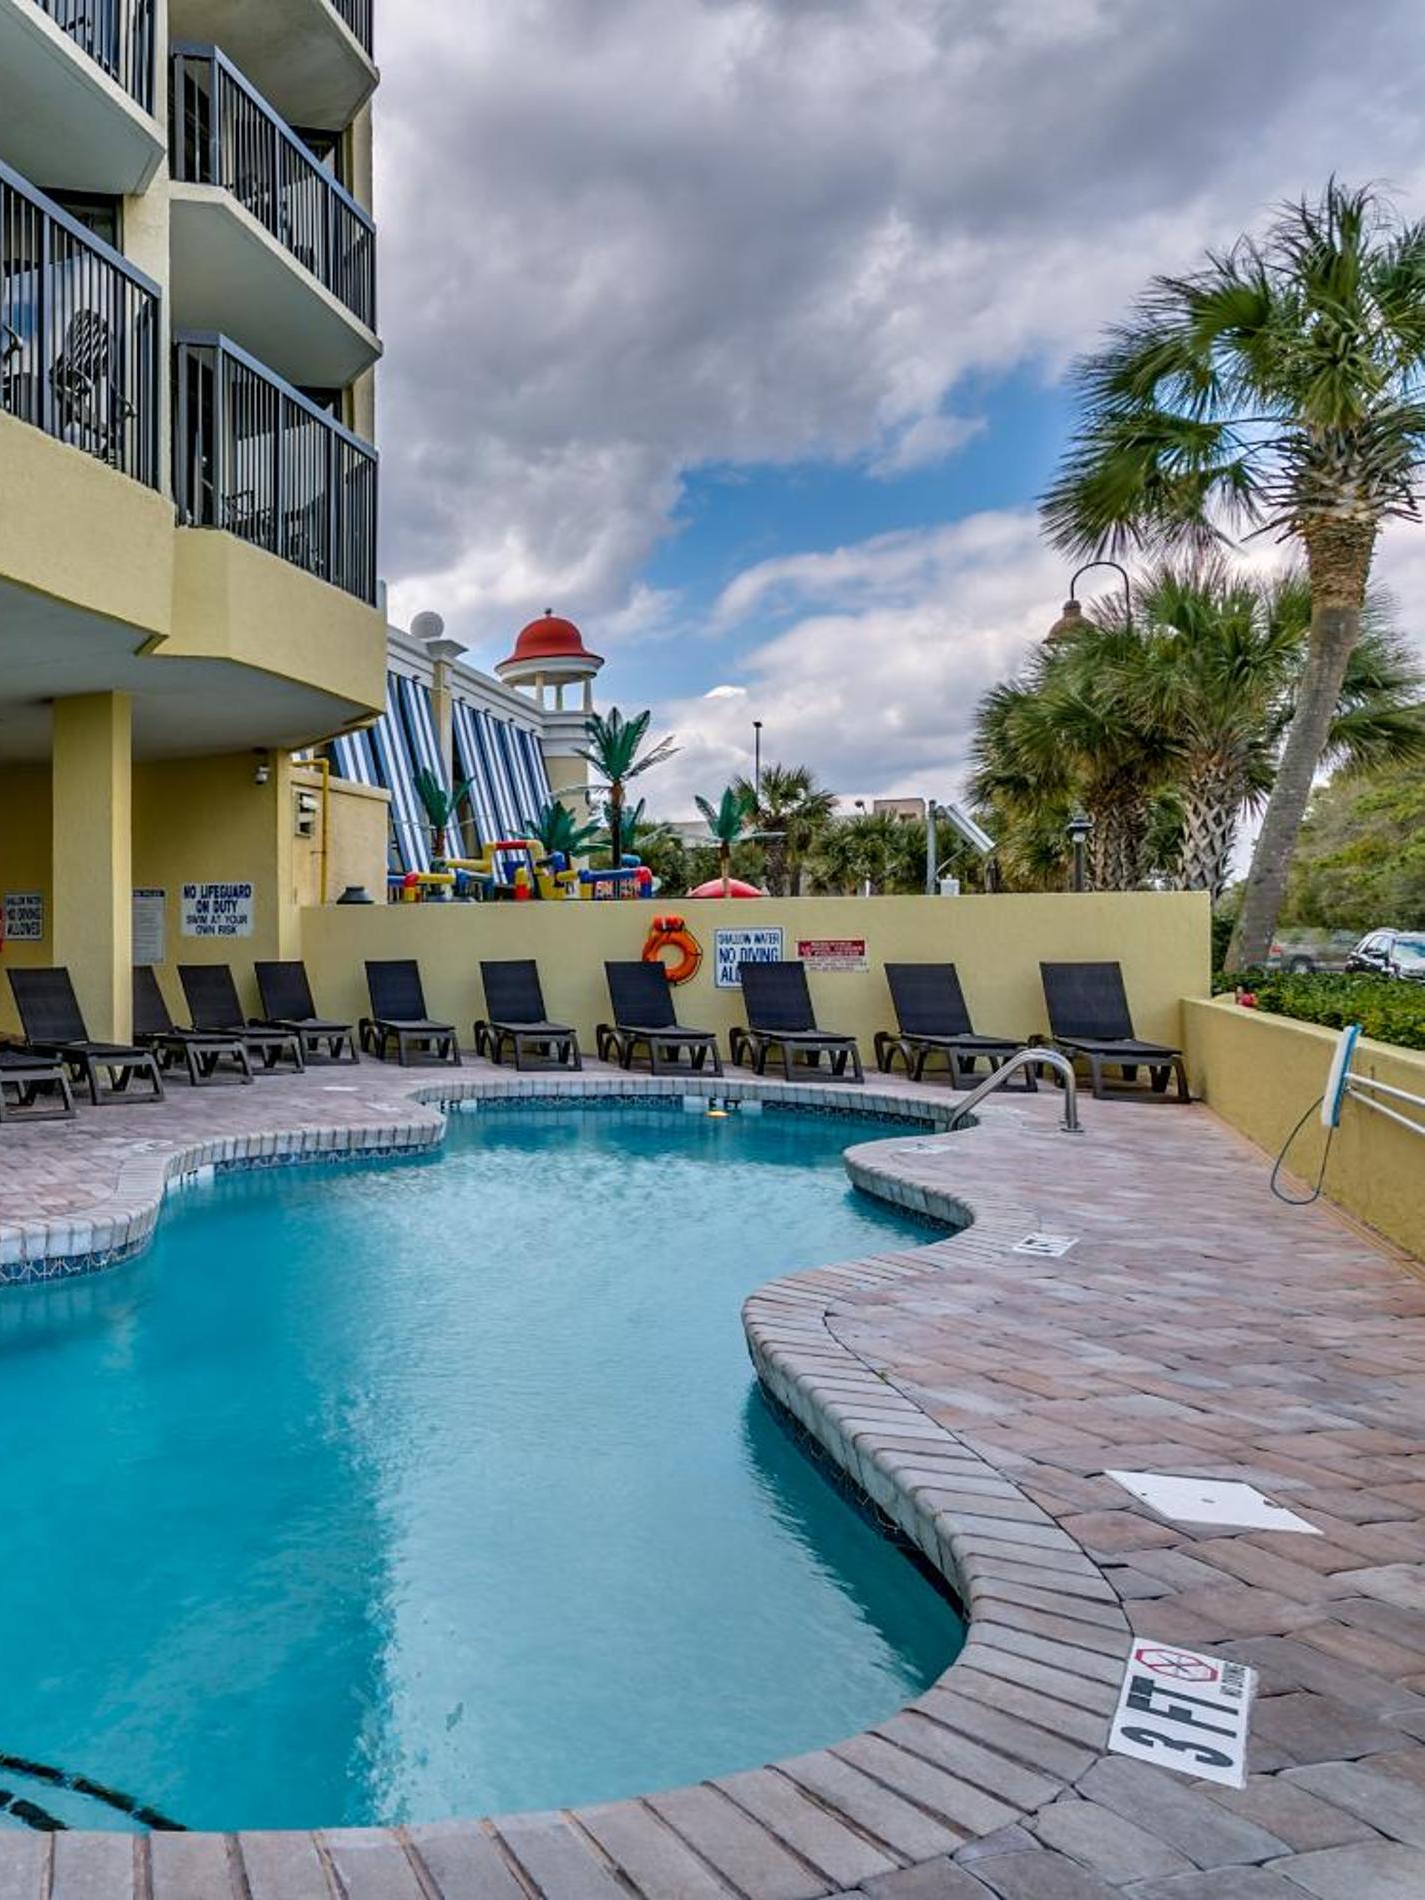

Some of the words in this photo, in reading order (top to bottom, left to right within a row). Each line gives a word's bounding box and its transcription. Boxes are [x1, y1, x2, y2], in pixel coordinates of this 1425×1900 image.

[183, 885, 196, 899] NO
[201, 885, 252, 899] LIFEGUARD
[196, 900, 209, 914] ON
[214, 900, 238, 914] DUTY
[719, 947, 736, 964] NO
[740, 947, 778, 963] DIVING
[1126, 1675, 1239, 1739] FT
[1121, 1726, 1234, 1767] 3
